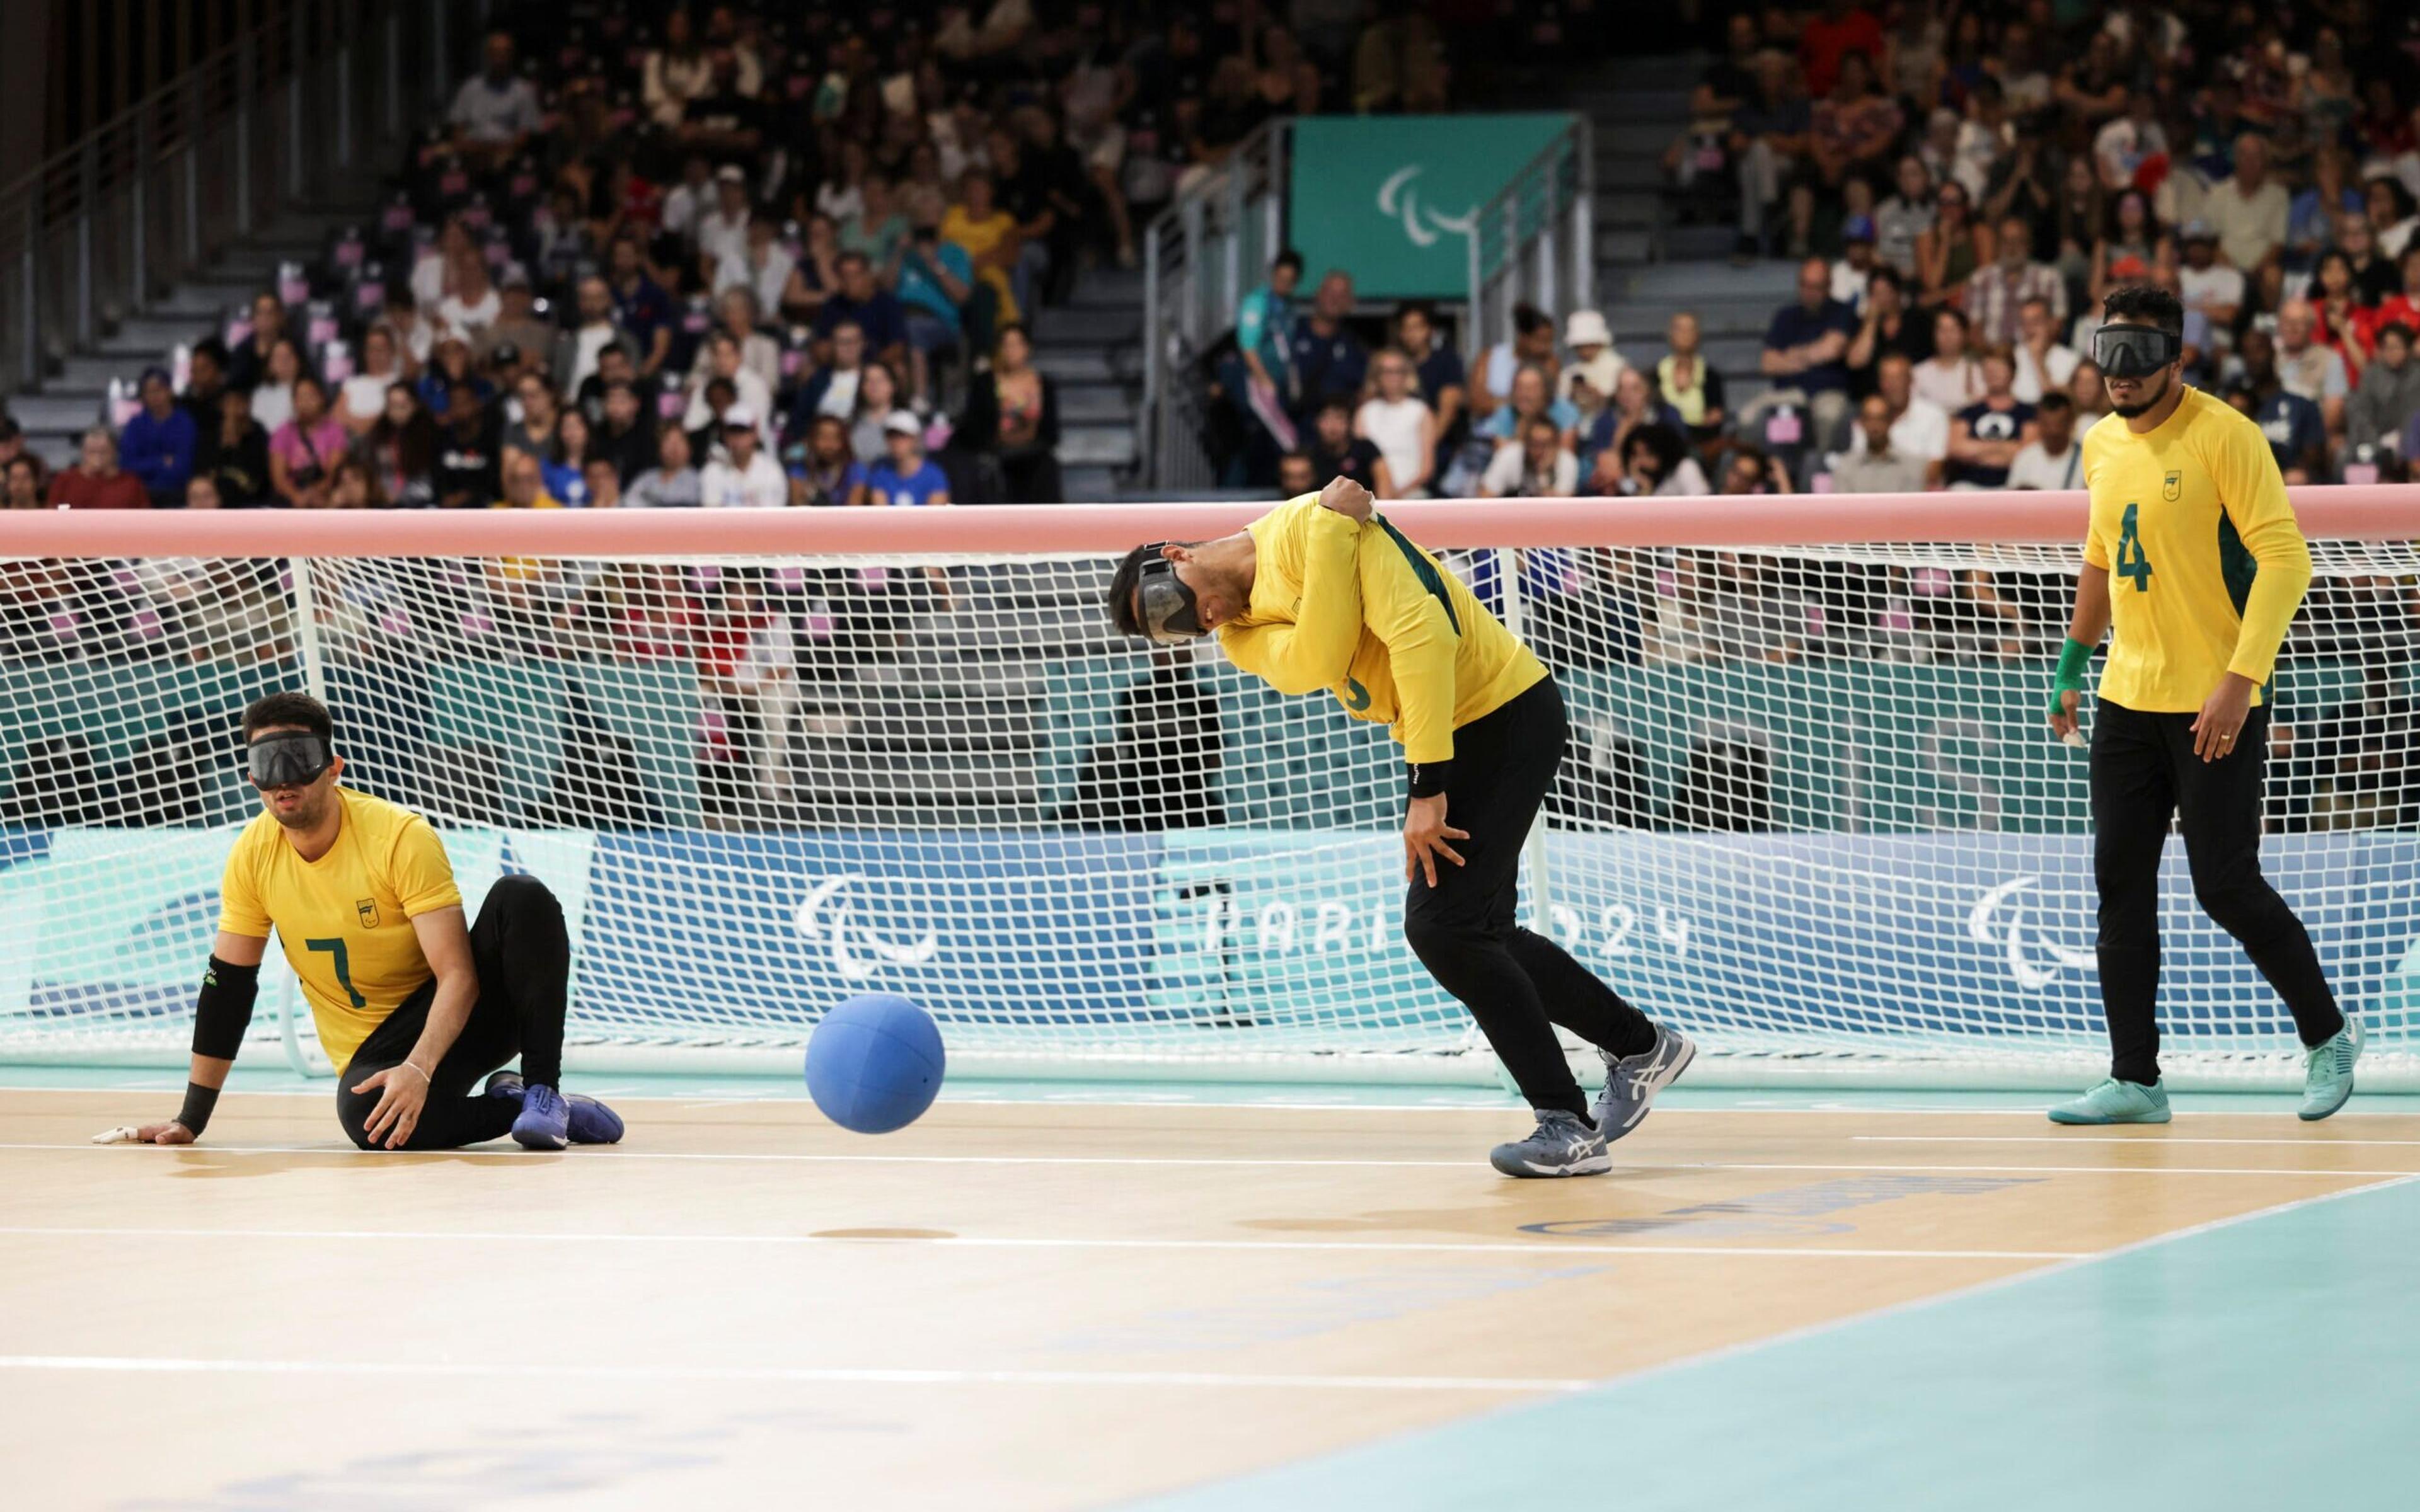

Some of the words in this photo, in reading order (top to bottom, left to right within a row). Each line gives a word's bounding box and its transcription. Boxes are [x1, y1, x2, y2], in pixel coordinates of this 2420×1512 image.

[2117, 503, 2152, 592] 4
[1204, 900, 1410, 953] PARI
[305, 937, 367, 1009] 7
